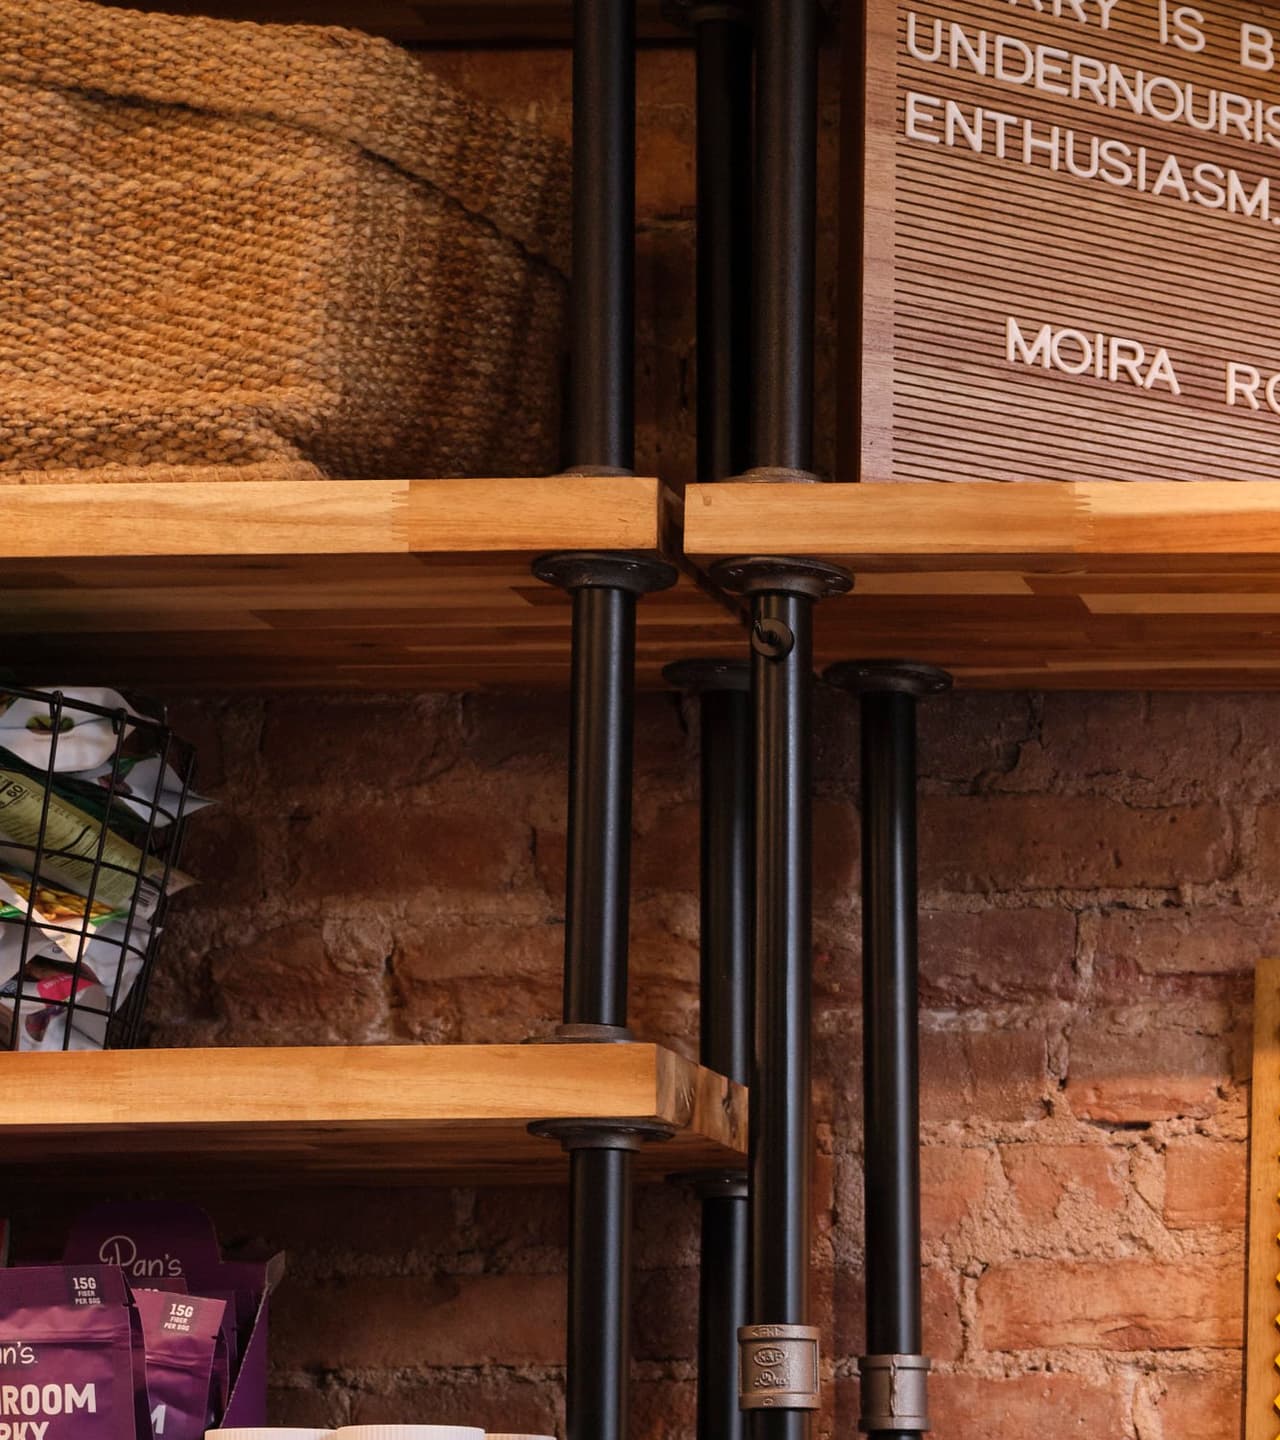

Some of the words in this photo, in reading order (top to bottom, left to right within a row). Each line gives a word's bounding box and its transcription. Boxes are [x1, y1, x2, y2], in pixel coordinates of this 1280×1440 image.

[1158, 0, 1206, 53] IS
[1005, 316, 1182, 397] MOIRA
[169, 1303, 195, 1318] 15G
